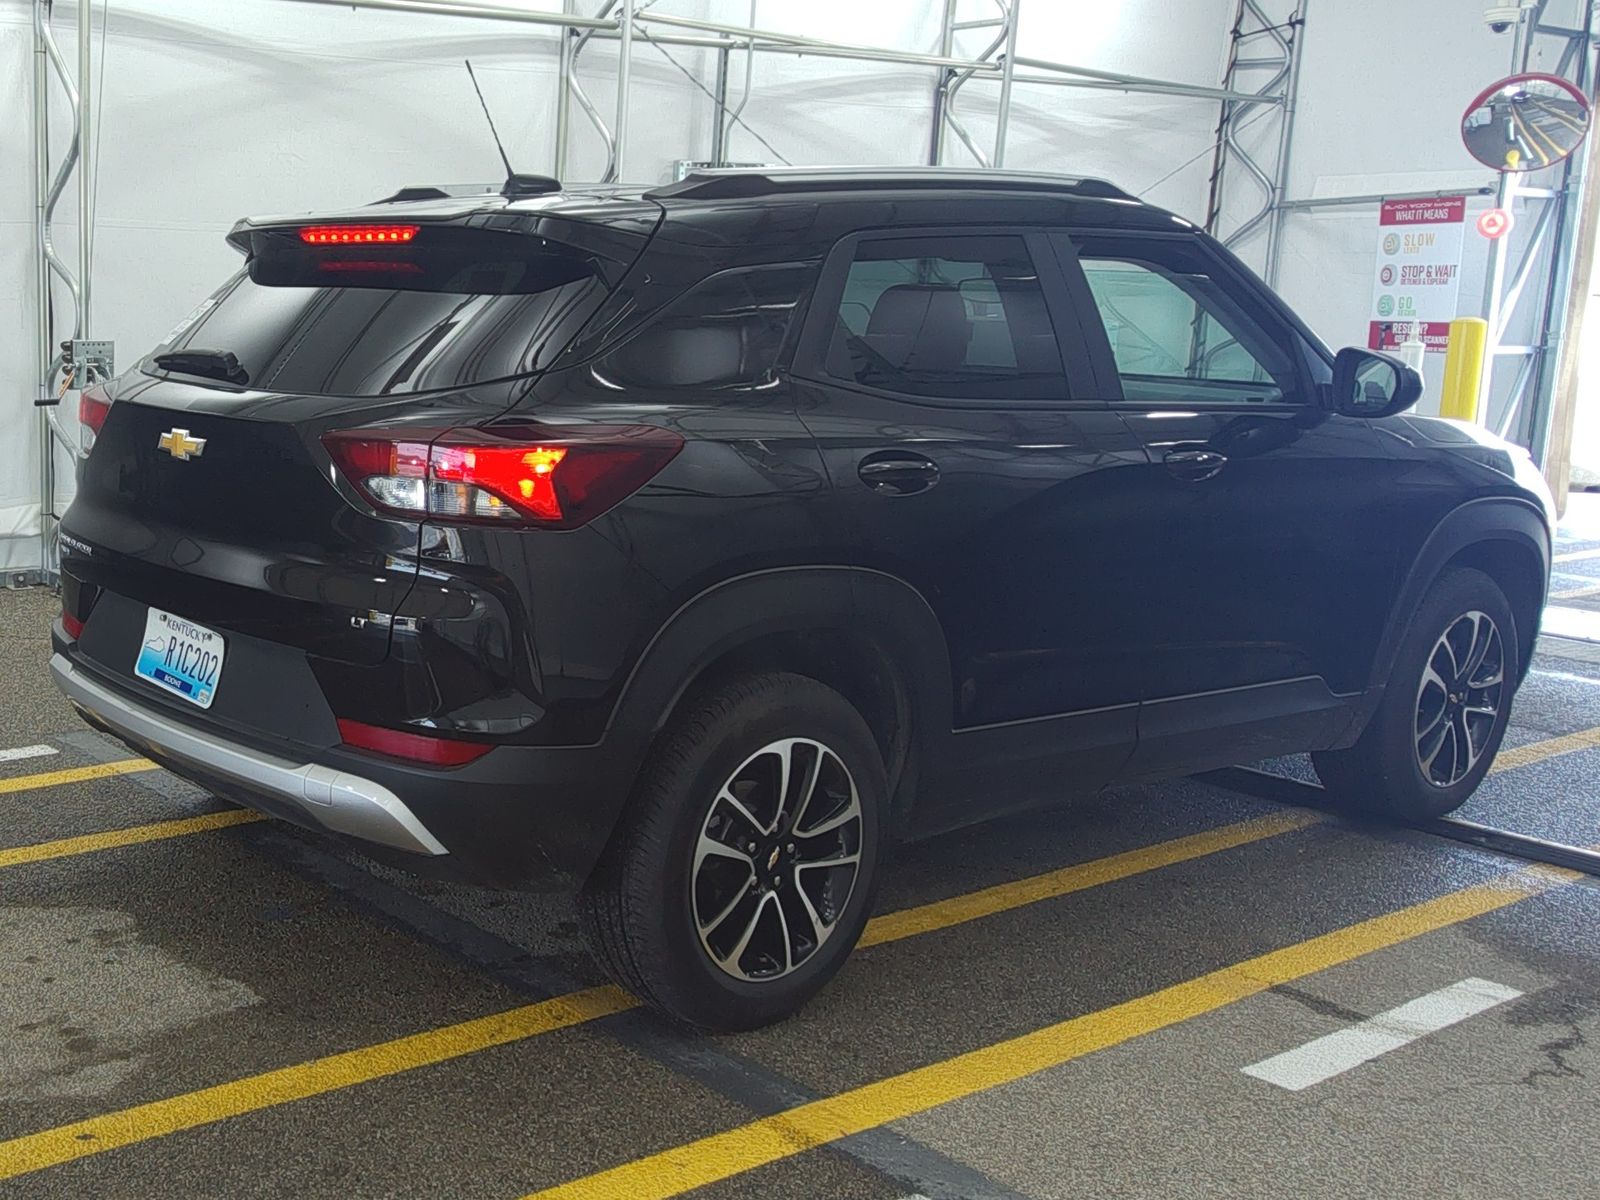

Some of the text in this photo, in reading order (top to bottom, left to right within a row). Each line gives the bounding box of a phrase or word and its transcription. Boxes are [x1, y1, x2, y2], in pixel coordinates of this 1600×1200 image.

[1395, 208, 1449, 221] WHAT IT MEANS
[1404, 233, 1435, 246] SLOW
[1401, 264, 1458, 278] STOP & WAIT
[1398, 296, 1413, 310] GO
[351, 616, 368, 629] LT
[166, 618, 207, 643] KENTUCKY
[164, 636, 218, 687] R1C202
